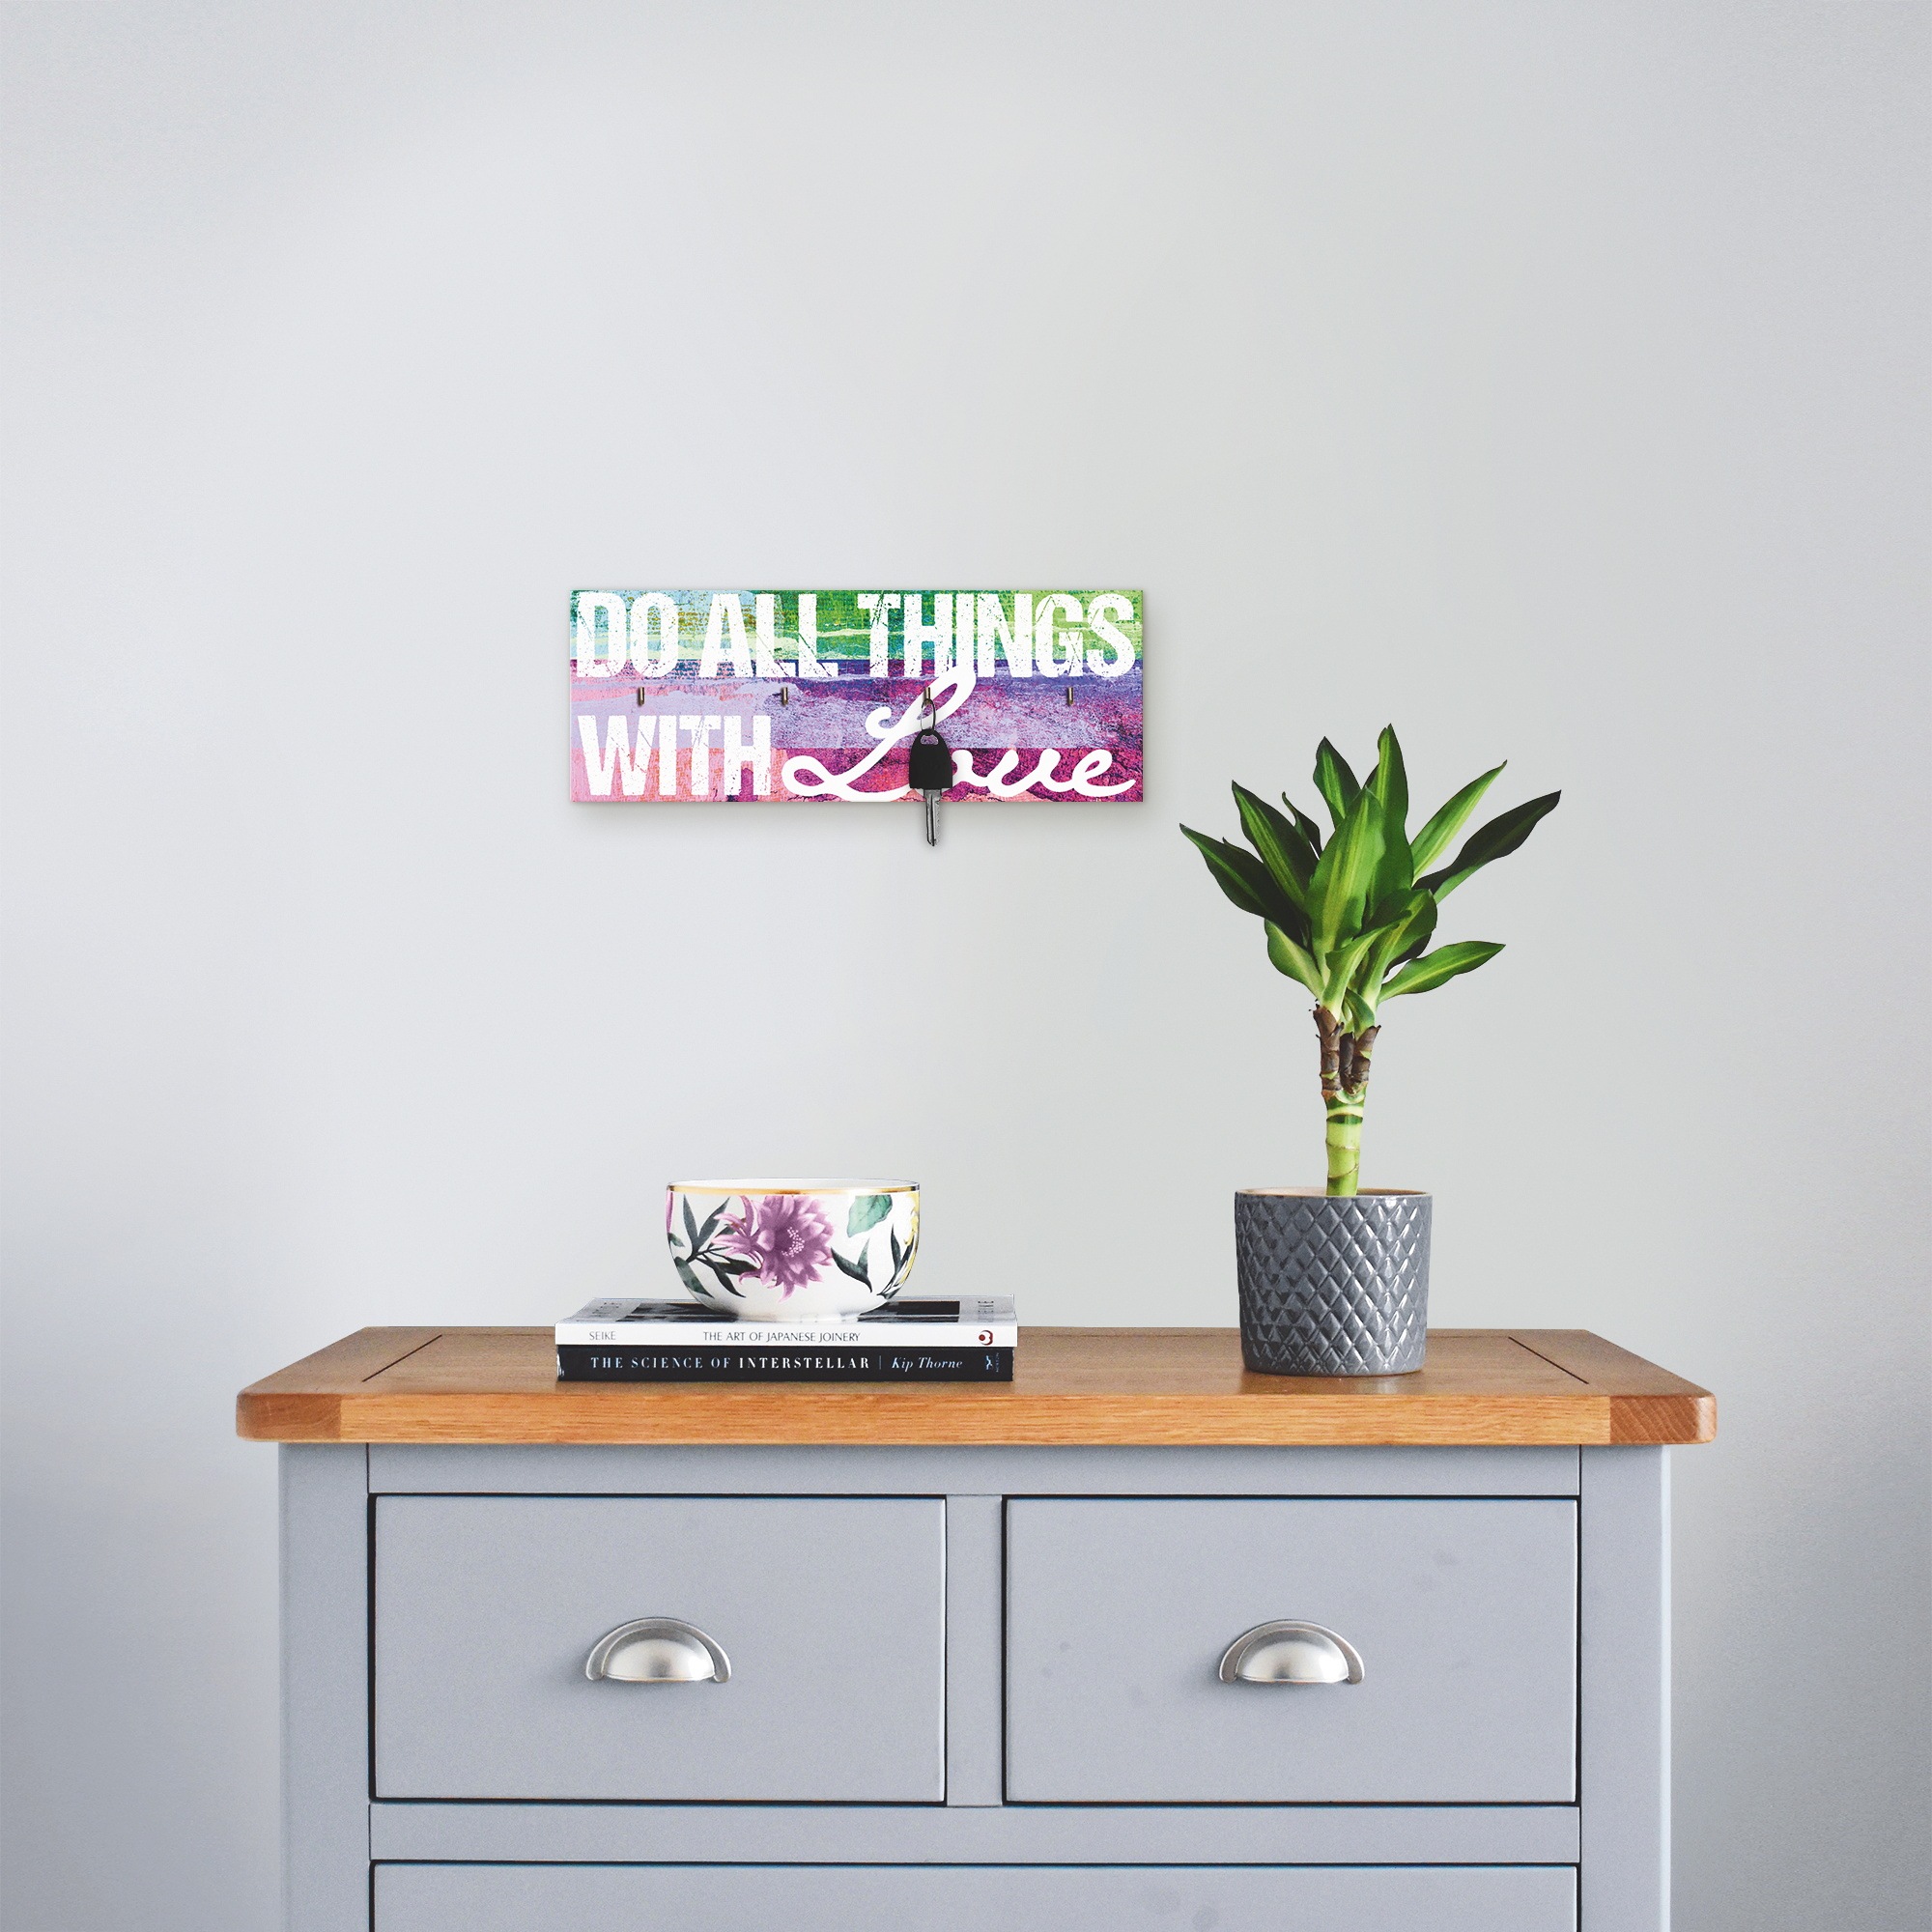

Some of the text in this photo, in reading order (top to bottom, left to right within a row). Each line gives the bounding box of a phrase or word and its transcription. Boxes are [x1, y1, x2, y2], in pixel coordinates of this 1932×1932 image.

[574, 592, 1137, 678] DO ALL THINGS
[577, 715, 772, 796] WITH
[589, 1331, 616, 1341] SEIKE
[703, 1331, 861, 1343] THE ART OF JAPANESE JOINERY
[590, 1357, 869, 1369] THE SCIENCE OF INTERSTELLAR
[891, 1356, 963, 1373] Kip Thorne
